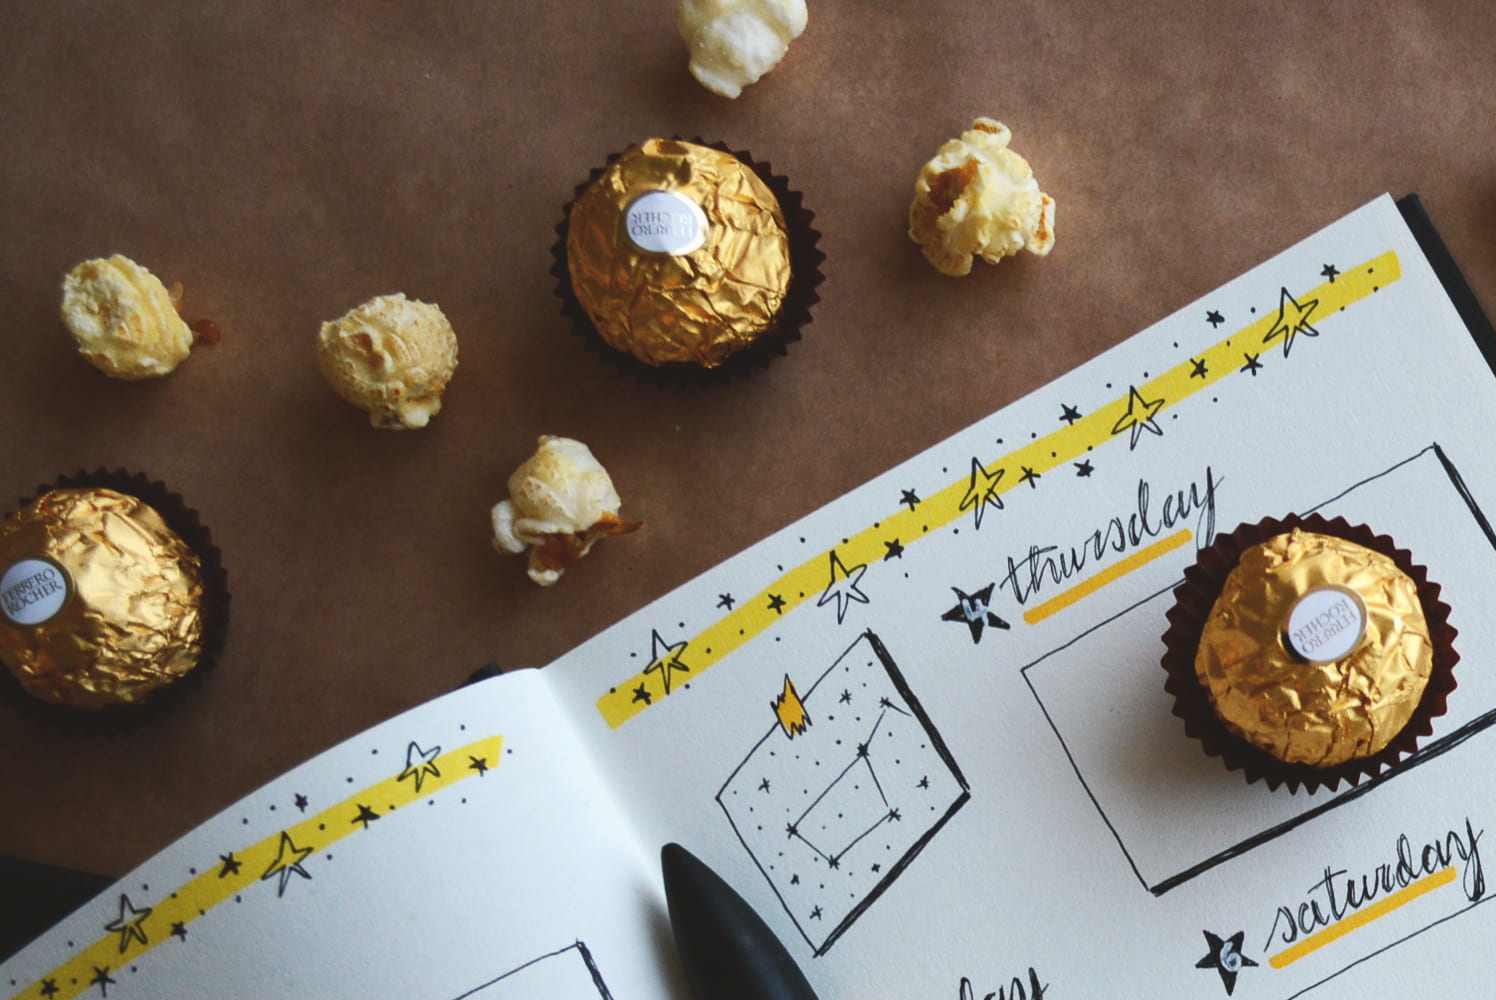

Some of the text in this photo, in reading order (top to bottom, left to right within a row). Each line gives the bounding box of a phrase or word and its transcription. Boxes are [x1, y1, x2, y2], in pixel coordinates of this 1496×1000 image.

[961, 465, 1225, 627] 4 thursday
[2, 568, 55, 604] FERRERO
[8, 580, 63, 615] ROCHER
[1293, 599, 1350, 642] ROCHER
[1301, 610, 1357, 654] FERRERO
[1219, 817, 1485, 973] 6 saturday
